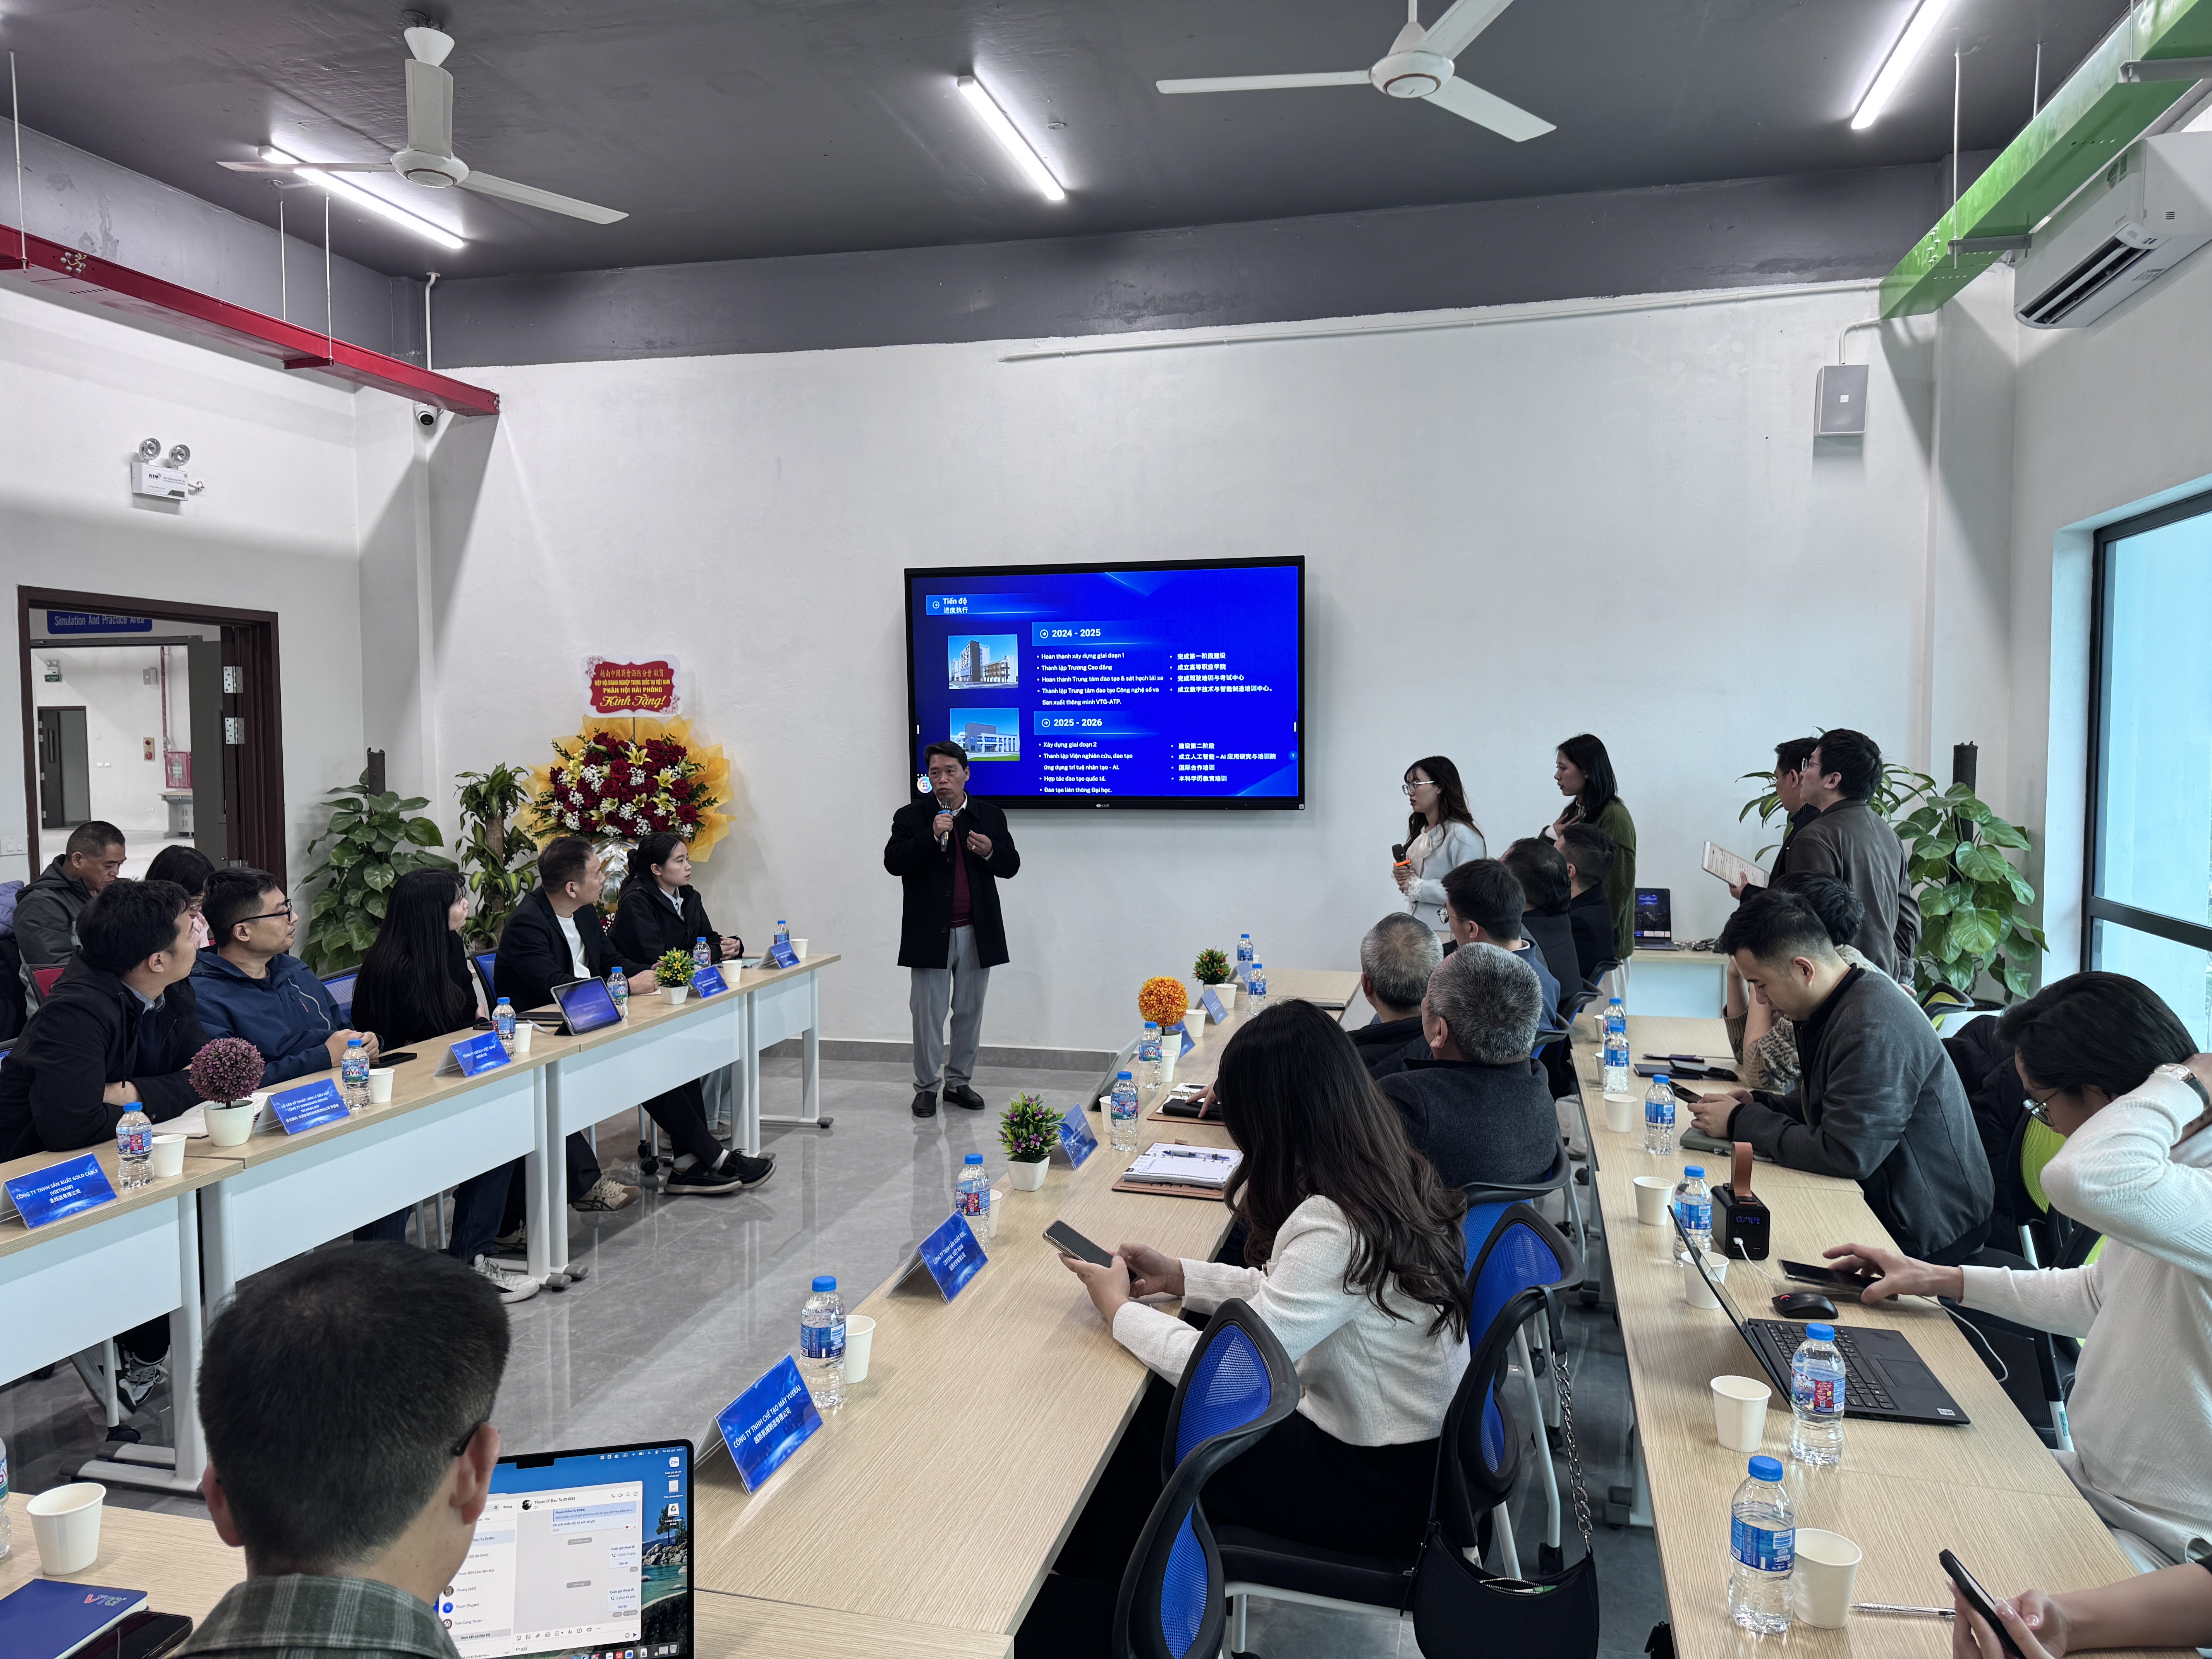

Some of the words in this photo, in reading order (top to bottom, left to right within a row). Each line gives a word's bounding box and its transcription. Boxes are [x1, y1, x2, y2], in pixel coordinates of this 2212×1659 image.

[958, 597, 967, 605] độ
[55, 615, 86, 626] Simulation
[88, 615, 100, 625] And
[102, 616, 127, 625] Practice
[600, 695, 631, 707] Kính
[632, 694, 667, 708] Tặng!
[16, 1191, 30, 1200] CÔNG
[36, 1185, 50, 1193] TNHH
[84, 1168, 99, 1176] CABLE
[50, 1185, 74, 1196] (VIETNAM)
[733, 1433, 747, 1448] CÔNG
[745, 1429, 752, 1437] TY
[750, 1419, 763, 1432] TNHH
[763, 1409, 771, 1422] CHẾ
[769, 1405, 779, 1415] TẠO
[778, 1397, 788, 1408] MÁY
[786, 1384, 802, 1400] YUEKAI
[84, 1594, 122, 1606] VTG
